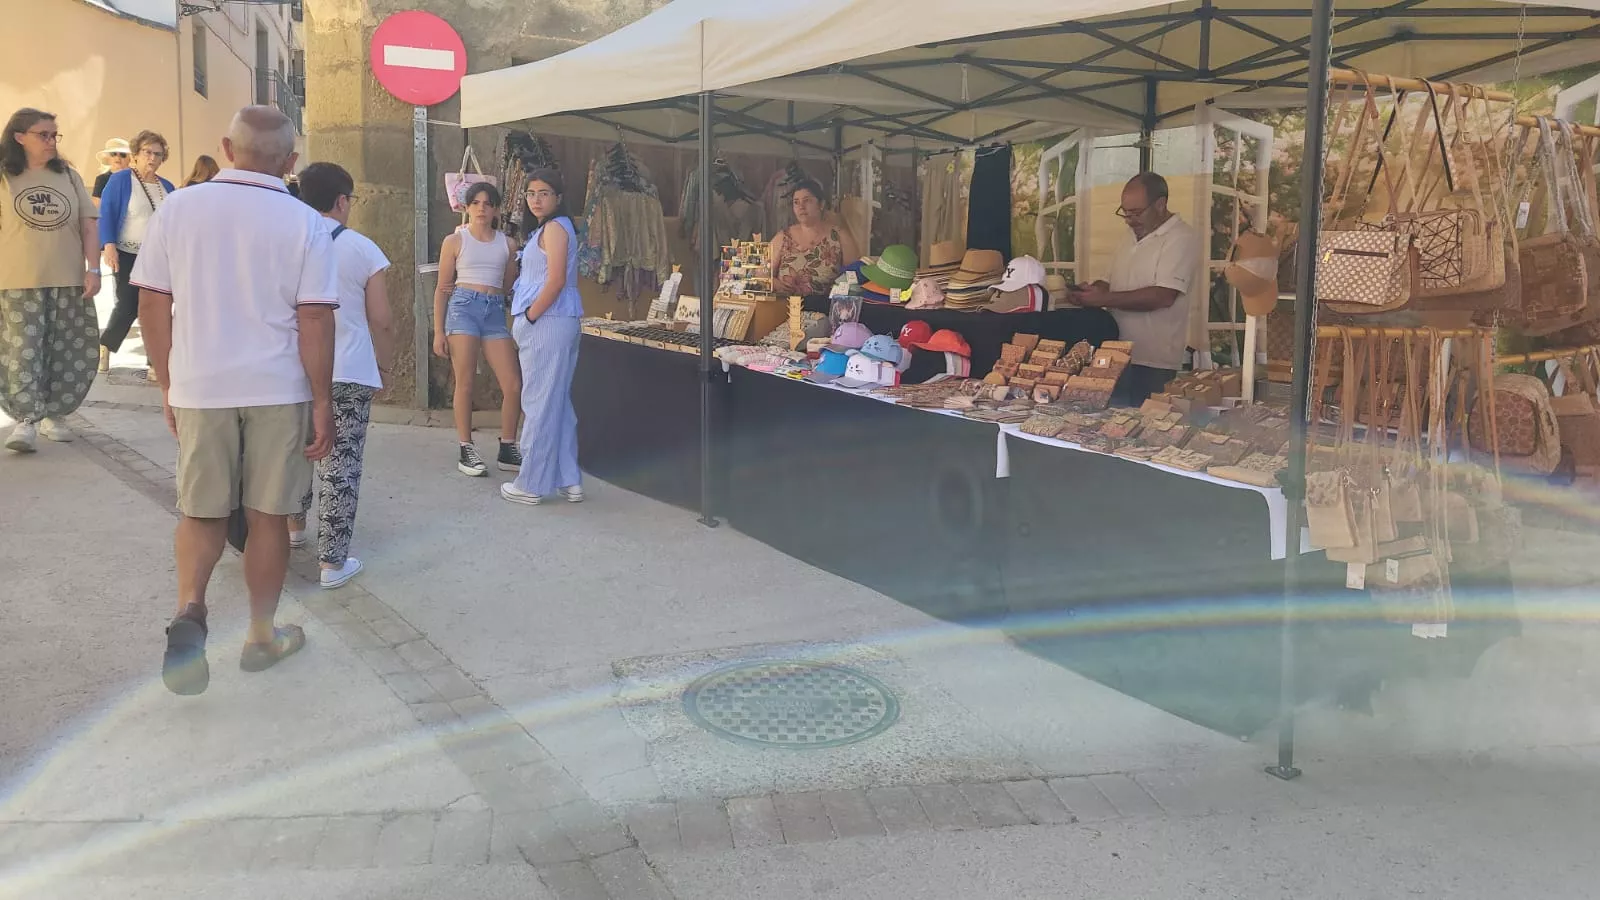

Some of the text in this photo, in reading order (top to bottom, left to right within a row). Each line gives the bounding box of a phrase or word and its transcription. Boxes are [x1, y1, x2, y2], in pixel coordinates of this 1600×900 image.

[27, 193, 51, 204] SIN
[1006, 268, 1015, 278] Y
[903, 327, 912, 336] Y
